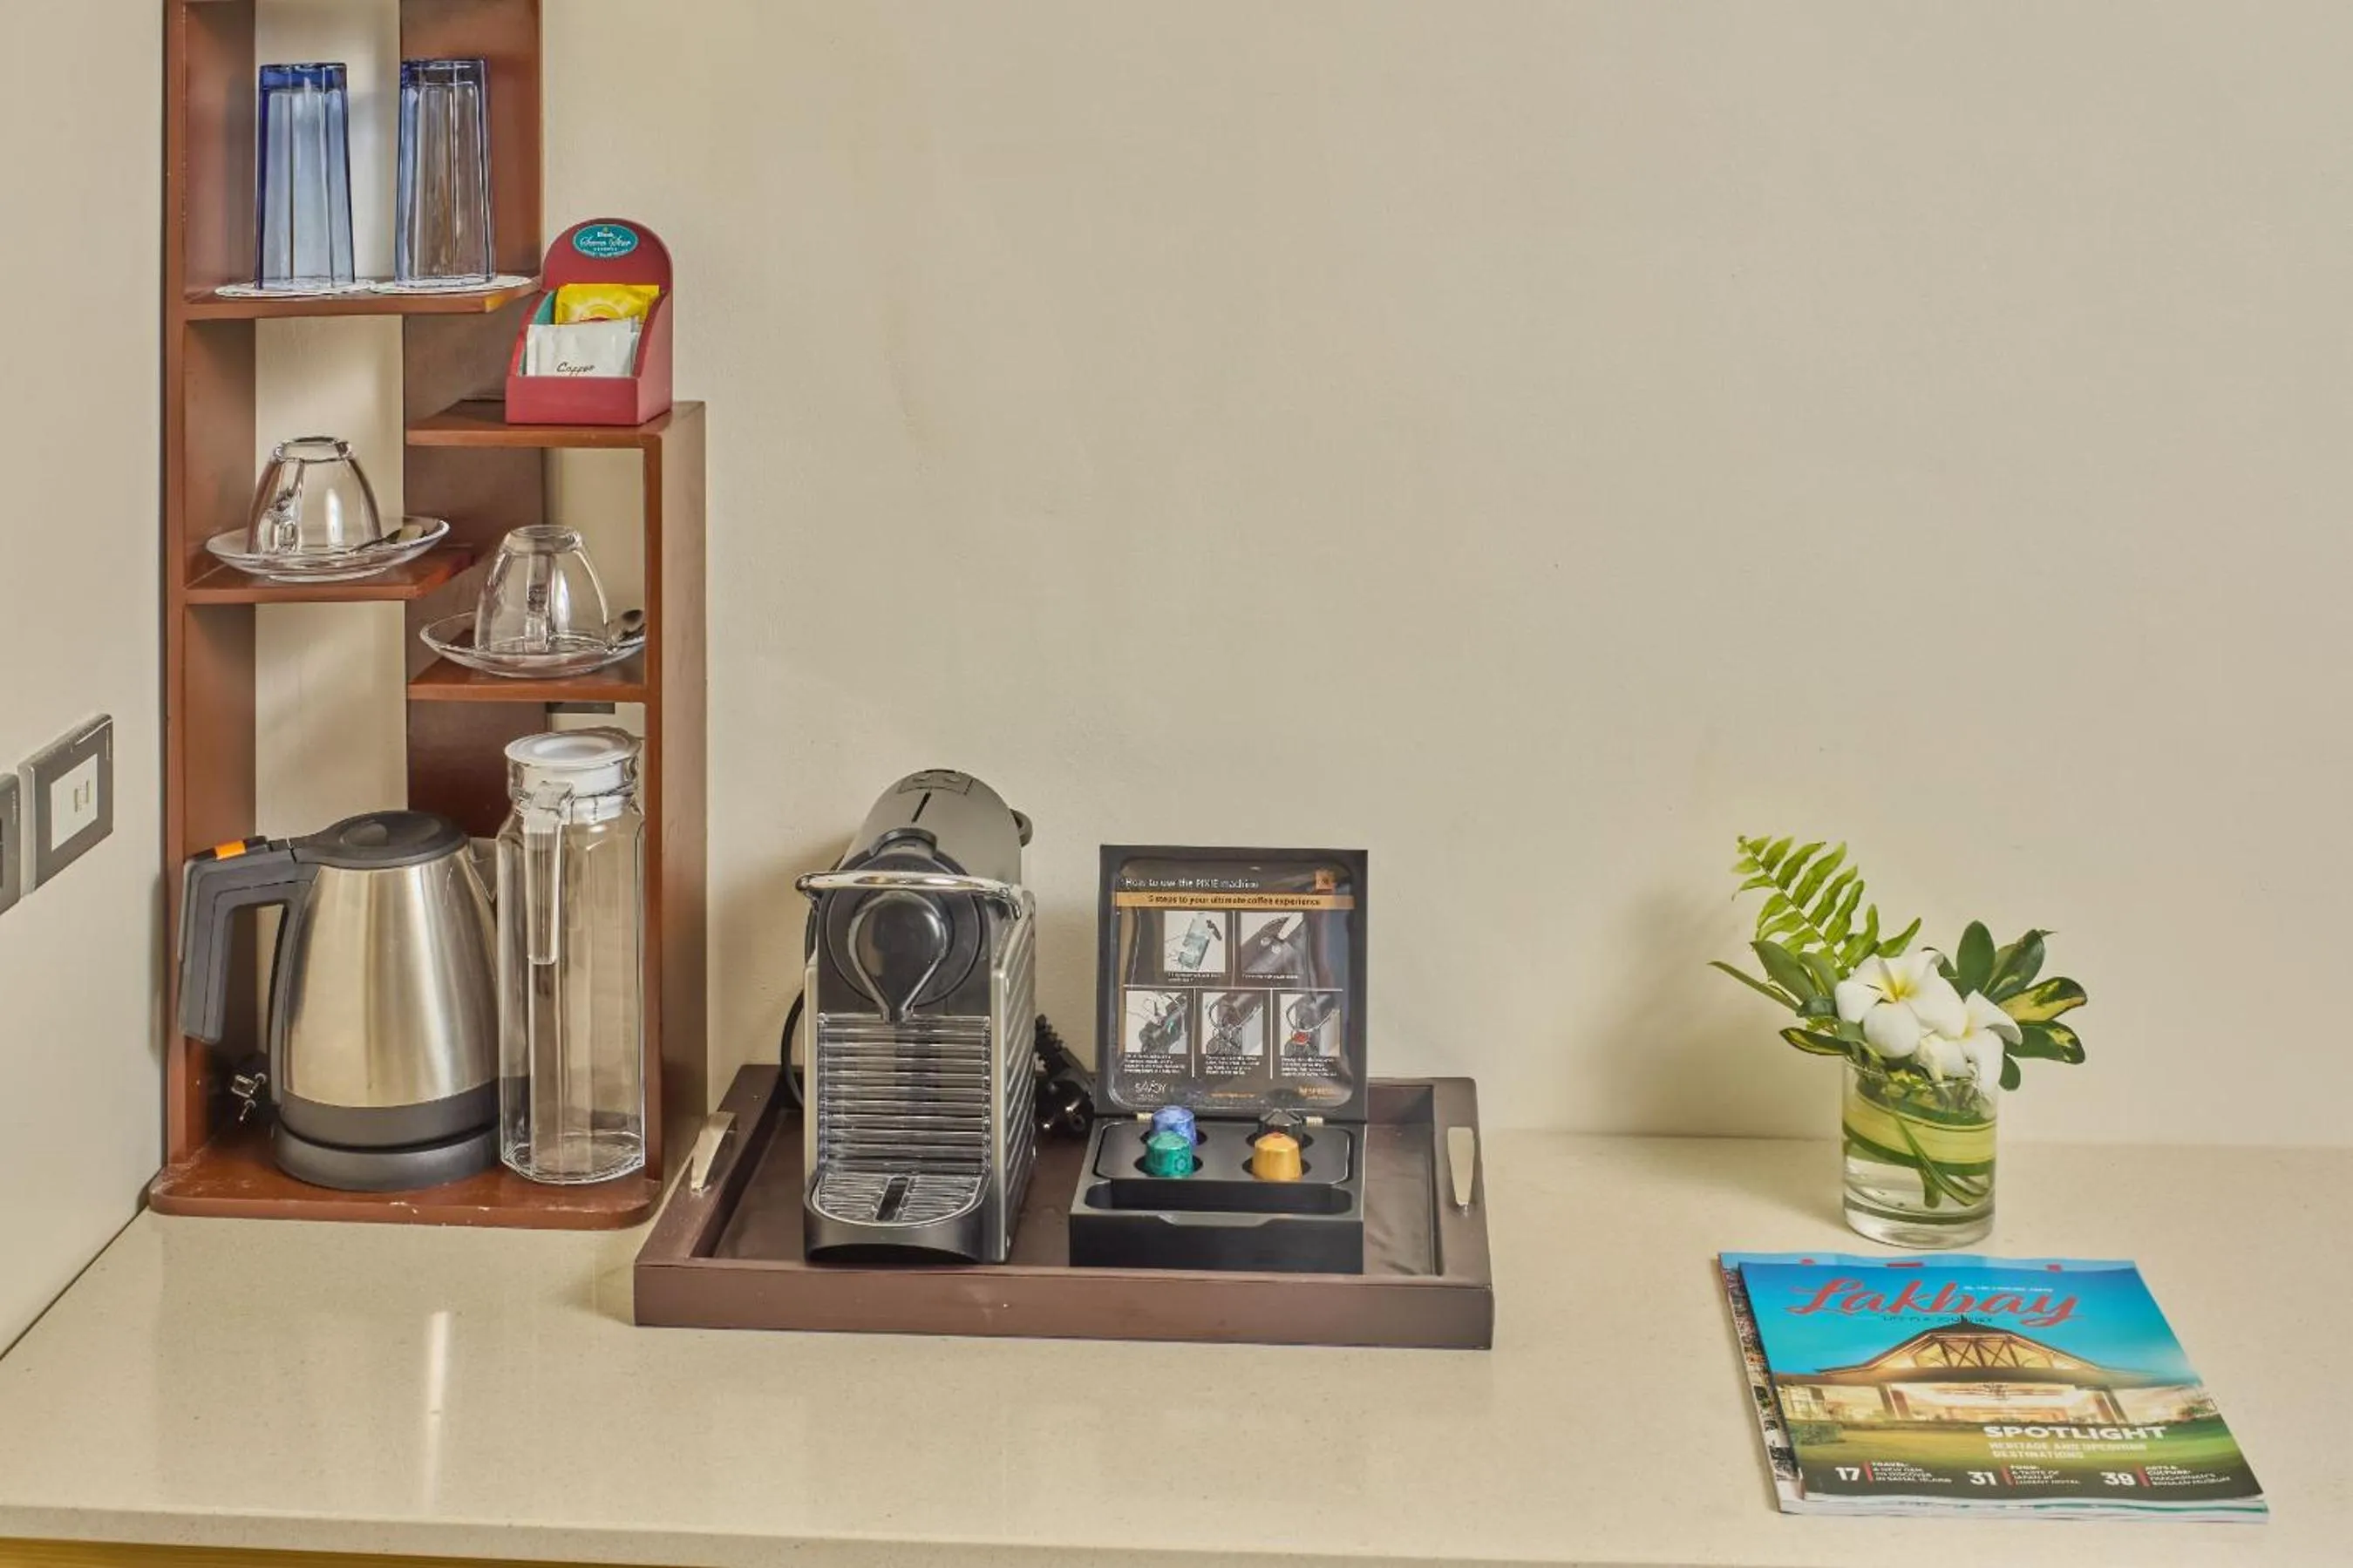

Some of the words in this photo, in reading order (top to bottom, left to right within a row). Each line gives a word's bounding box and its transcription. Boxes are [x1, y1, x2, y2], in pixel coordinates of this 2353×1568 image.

[1149, 878, 1159, 887] to
[1179, 877, 1194, 887] the
[1189, 897, 1208, 906] your
[1247, 896, 1273, 905] coffee
[1275, 897, 1321, 906] experience
[1787, 1277, 2084, 1327] Lakbay
[1983, 1425, 2167, 1441] SPOTLIGHT
[1834, 1467, 1860, 1482] 17
[1966, 1471, 1998, 1486] 31
